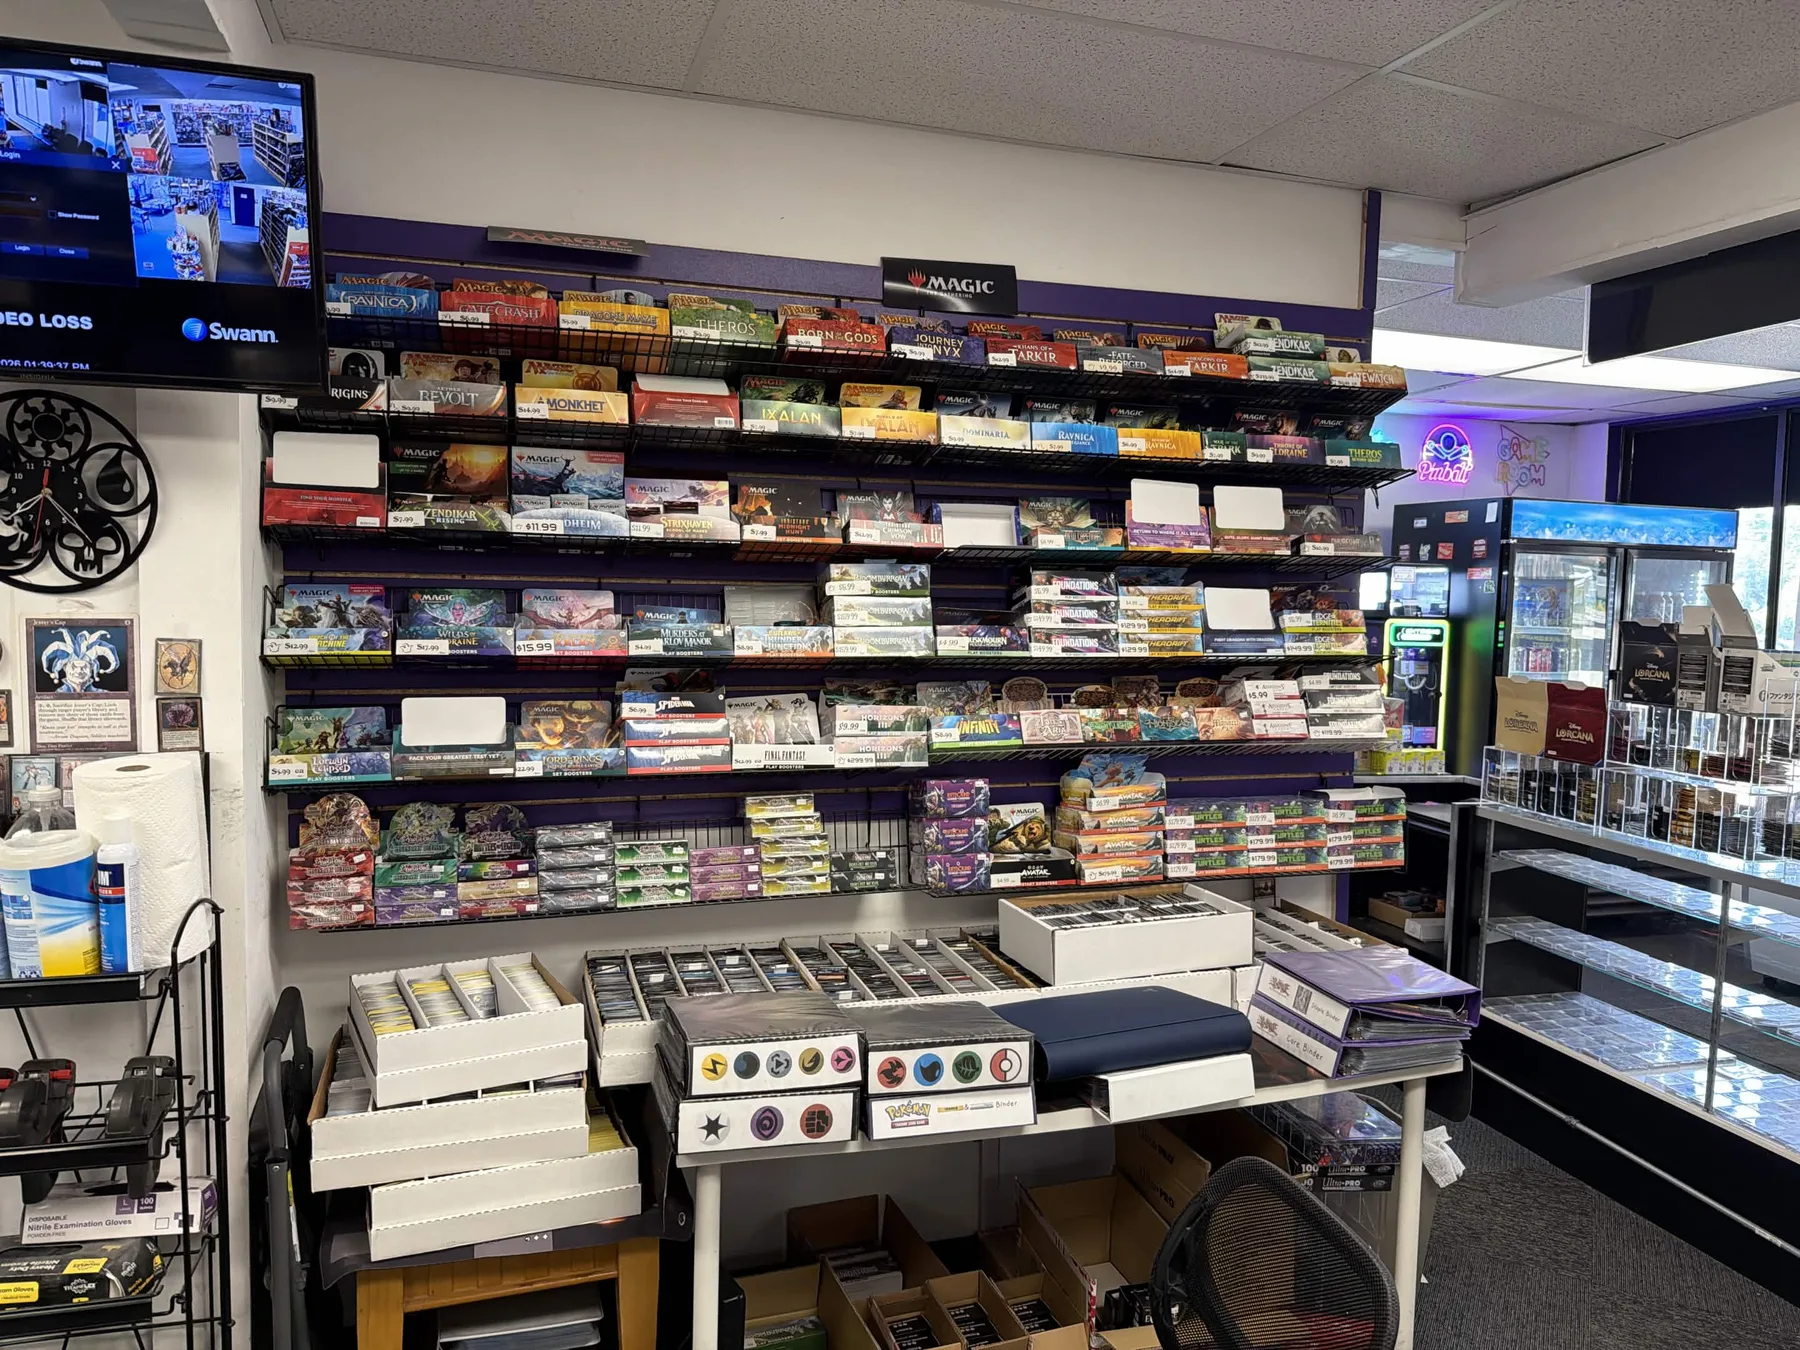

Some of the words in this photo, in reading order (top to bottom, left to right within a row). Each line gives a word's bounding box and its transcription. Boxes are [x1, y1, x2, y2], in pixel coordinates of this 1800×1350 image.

[927, 275, 995, 294] MAGIC
[346, 292, 408, 309] RAVNICA
[459, 304, 540, 319] GATECRASH
[40, 314, 93, 330] LOSS
[1218, 315, 1250, 323] MAGIC
[696, 319, 756, 336] THEROS
[209, 322, 279, 344] Swann.
[797, 329, 834, 340] BORN
[845, 332, 878, 344] GODS
[1056, 330, 1091, 340] MAGIC
[915, 334, 963, 348] JOURNEY
[1008, 349, 1058, 363] TARKIR
[1184, 360, 1229, 373] TARKIR
[1271, 365, 1315, 378] ZENDIKAR
[744, 377, 786, 389] MAGIC
[1346, 372, 1394, 384] GATEWATCH
[419, 390, 478, 408] REVOLT
[944, 396, 973, 404] MAGIC
[533, 398, 605, 413] AMONKHET
[1033, 402, 1060, 410] MAGIC
[762, 408, 821, 425] IXALAN
[1241, 413, 1267, 421] MAGIC
[963, 428, 1010, 439] DOMINARIA
[1058, 431, 1094, 442] RAVNICA
[1145, 441, 1176, 450] RAVNICA
[1497, 436, 1549, 463] GAME
[403, 449, 439, 457] MAGIC
[1269, 449, 1308, 458] ELDRAINE
[1348, 449, 1382, 458] THEROS
[526, 454, 560, 463] MAGIC
[1418, 461, 1473, 484] Pinball
[1497, 462, 1545, 487] ROOM
[424, 508, 477, 521] ZENDIKAR
[526, 523, 557, 531] $11.99
[660, 517, 712, 529] STRIXHAVEN
[883, 527, 912, 535] CRIMSON
[1052, 581, 1098, 590] FOUNDATIONS
[1052, 609, 1098, 618] FOUNDATIONS
[661, 629, 697, 637] MURDERS
[516, 642, 552, 651] $15.99
[685, 637, 712, 647] MANOR
[1052, 638, 1098, 648] FOUNDATIONS
[1323, 672, 1361, 681] FOUNDATIONS
[1635, 669, 1670, 680] LORCANA
[861, 714, 905, 722] HORIZONS
[1505, 717, 1538, 732] LORCANA
[1556, 728, 1594, 742] LORCANA
[765, 751, 781, 760] FINAL
[782, 751, 806, 760] FANTASY
[1119, 792, 1146, 800] AVATAR
[1016, 807, 1039, 815] MAGIC
[1107, 816, 1138, 824] AVATAR
[1105, 841, 1134, 849] AVATAR
[1021, 868, 1051, 876] AVATAR
[1303, 1043, 1323, 1060] Binder
[1301, 1164, 1319, 1172] 100
[54, 1221, 102, 1230] Examination
